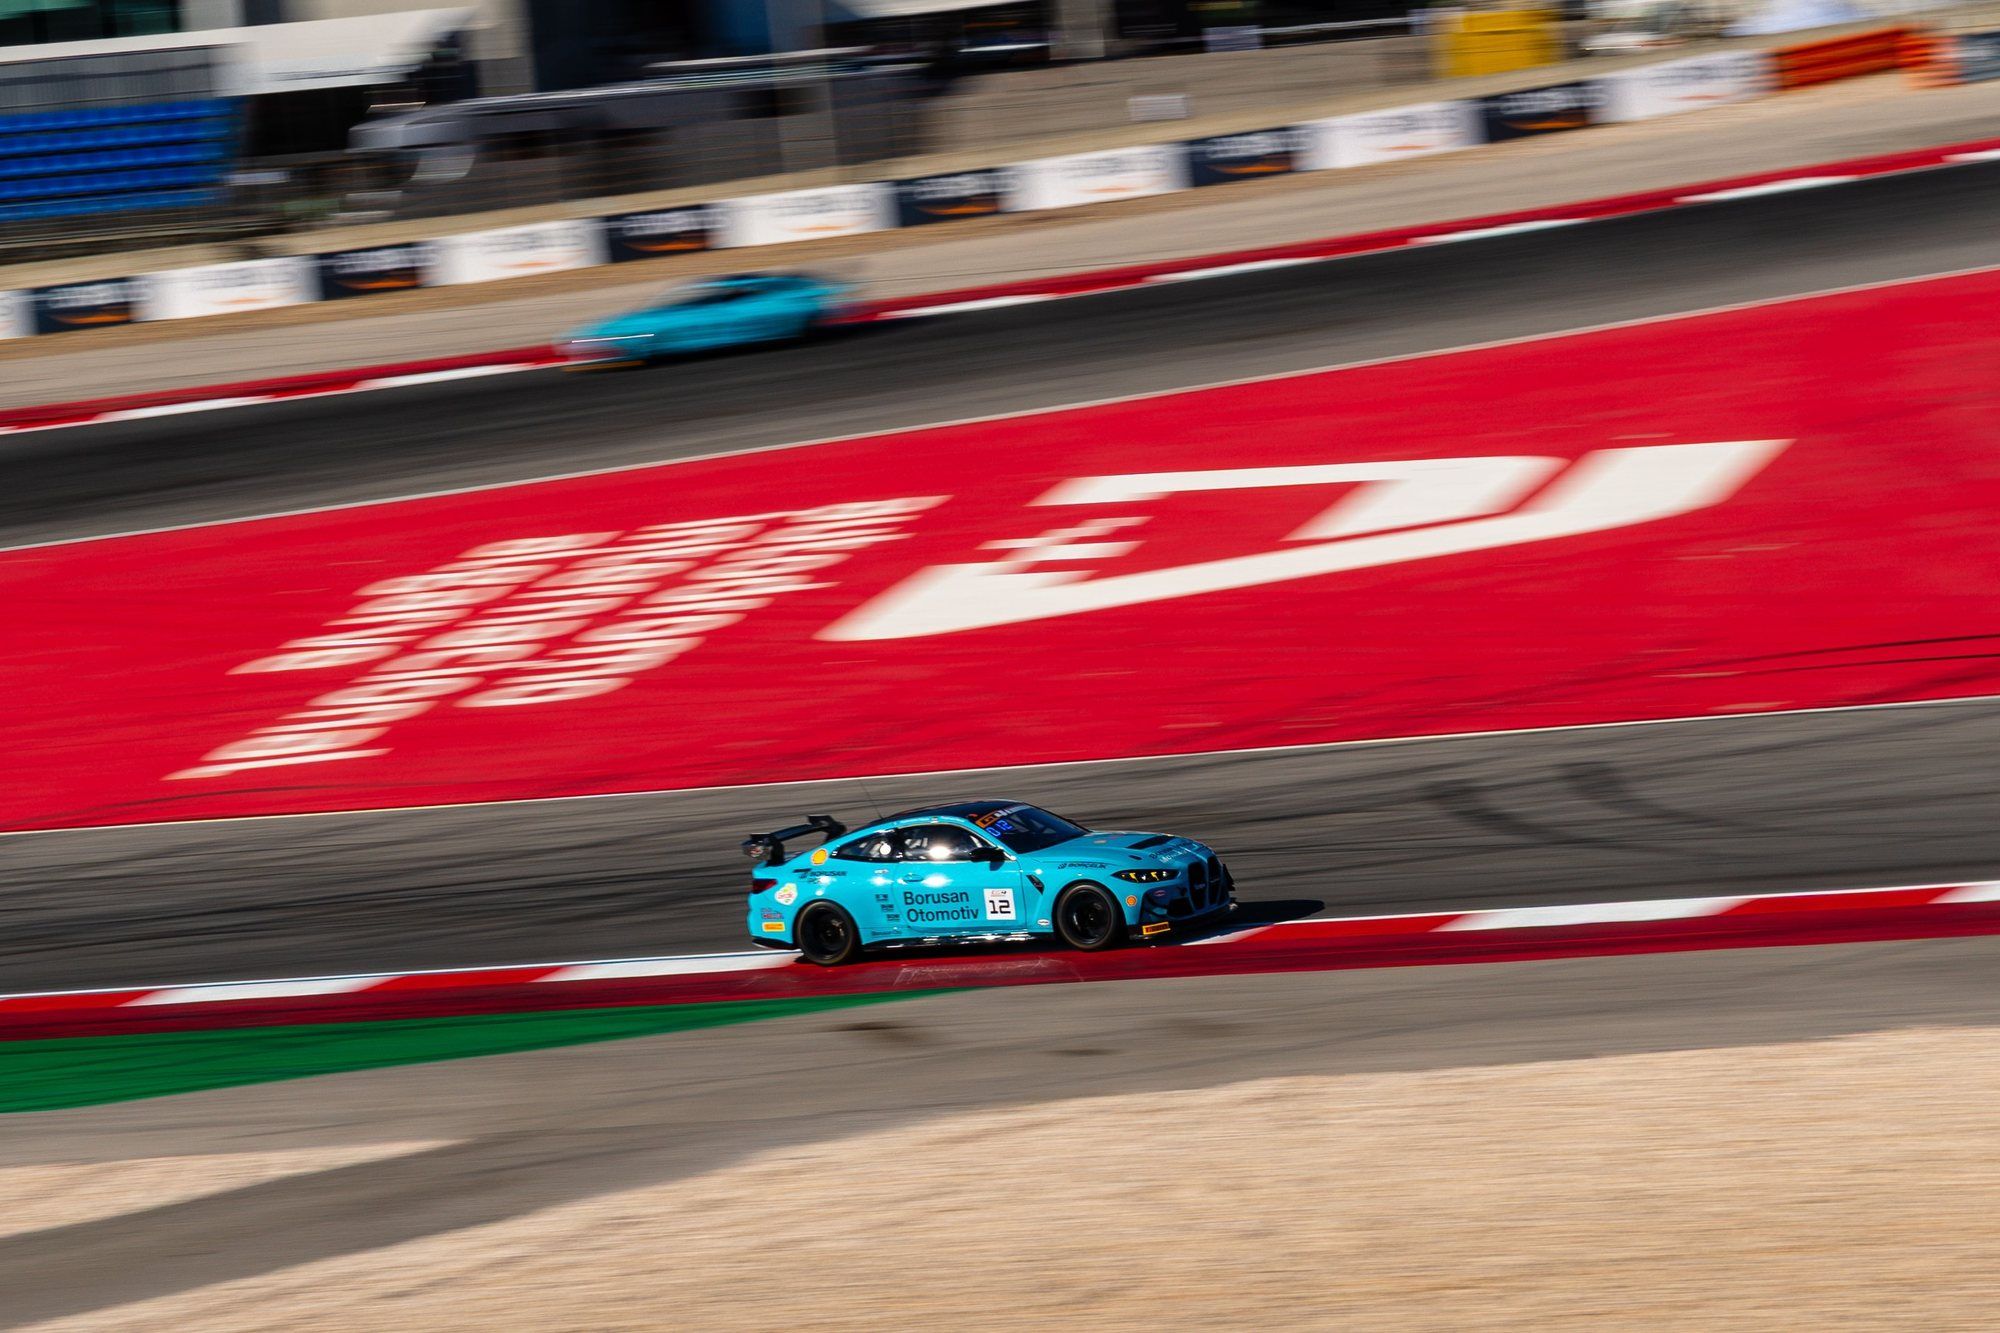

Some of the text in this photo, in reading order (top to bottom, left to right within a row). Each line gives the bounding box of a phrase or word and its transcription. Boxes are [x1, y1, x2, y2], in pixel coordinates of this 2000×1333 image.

[903, 891, 970, 906] Borusan
[988, 899, 1012, 914] 12
[907, 906, 979, 923] Otomotiv
